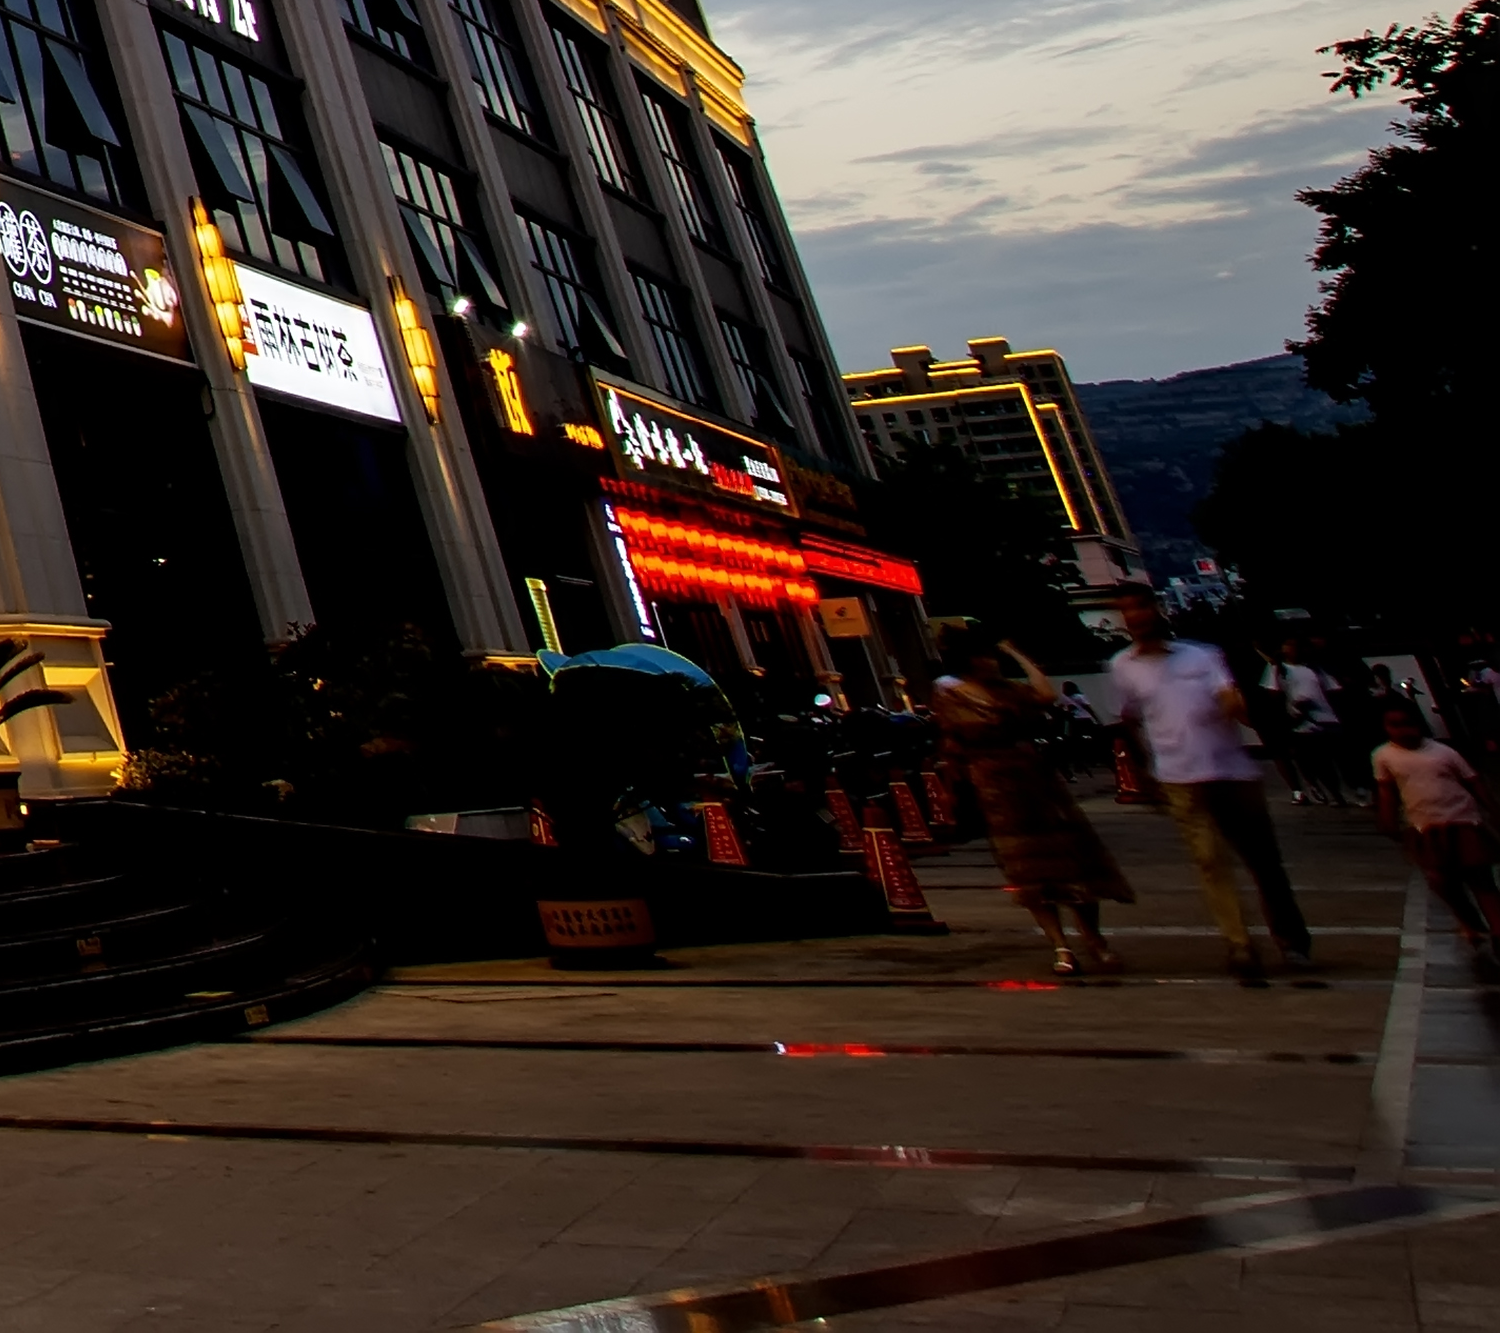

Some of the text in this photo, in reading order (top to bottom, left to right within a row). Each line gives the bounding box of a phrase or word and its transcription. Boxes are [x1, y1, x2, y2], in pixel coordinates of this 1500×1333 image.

[249, 297, 358, 383] 雨林古树茶
